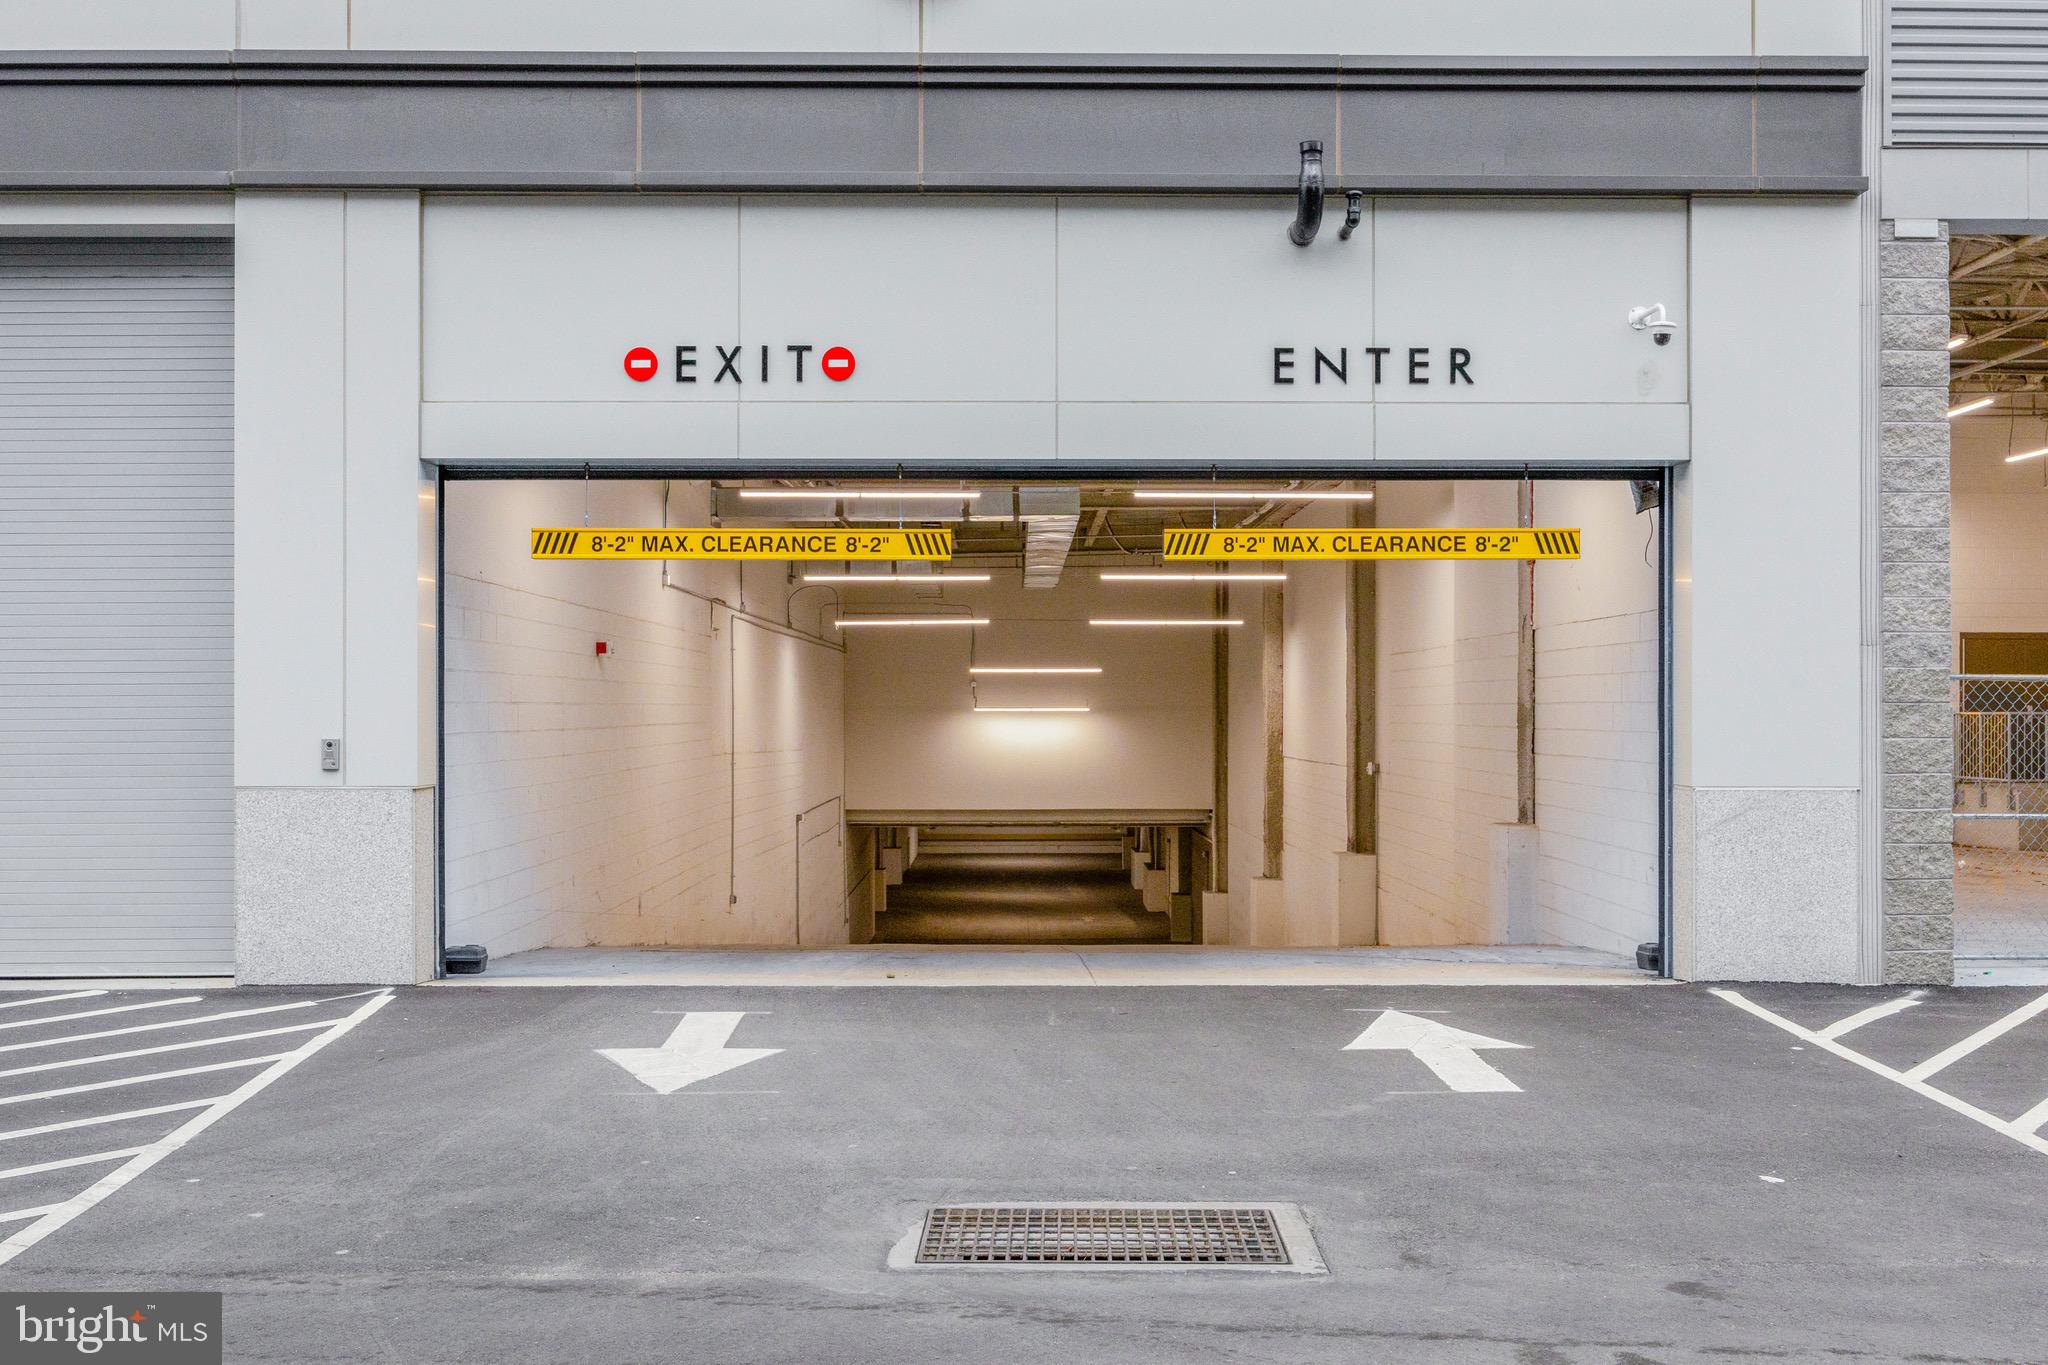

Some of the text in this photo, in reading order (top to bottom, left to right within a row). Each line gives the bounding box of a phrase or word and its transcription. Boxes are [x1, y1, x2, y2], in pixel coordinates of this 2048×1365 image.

[675, 345, 812, 383] EXIT
[1273, 346, 1474, 384] ENTER
[591, 535, 889, 553] 8'-2" MAX. CLEARANCE 8'-2"
[1223, 535, 1519, 553] 8'-2" MAX. CLEARANCE 8'-2"
